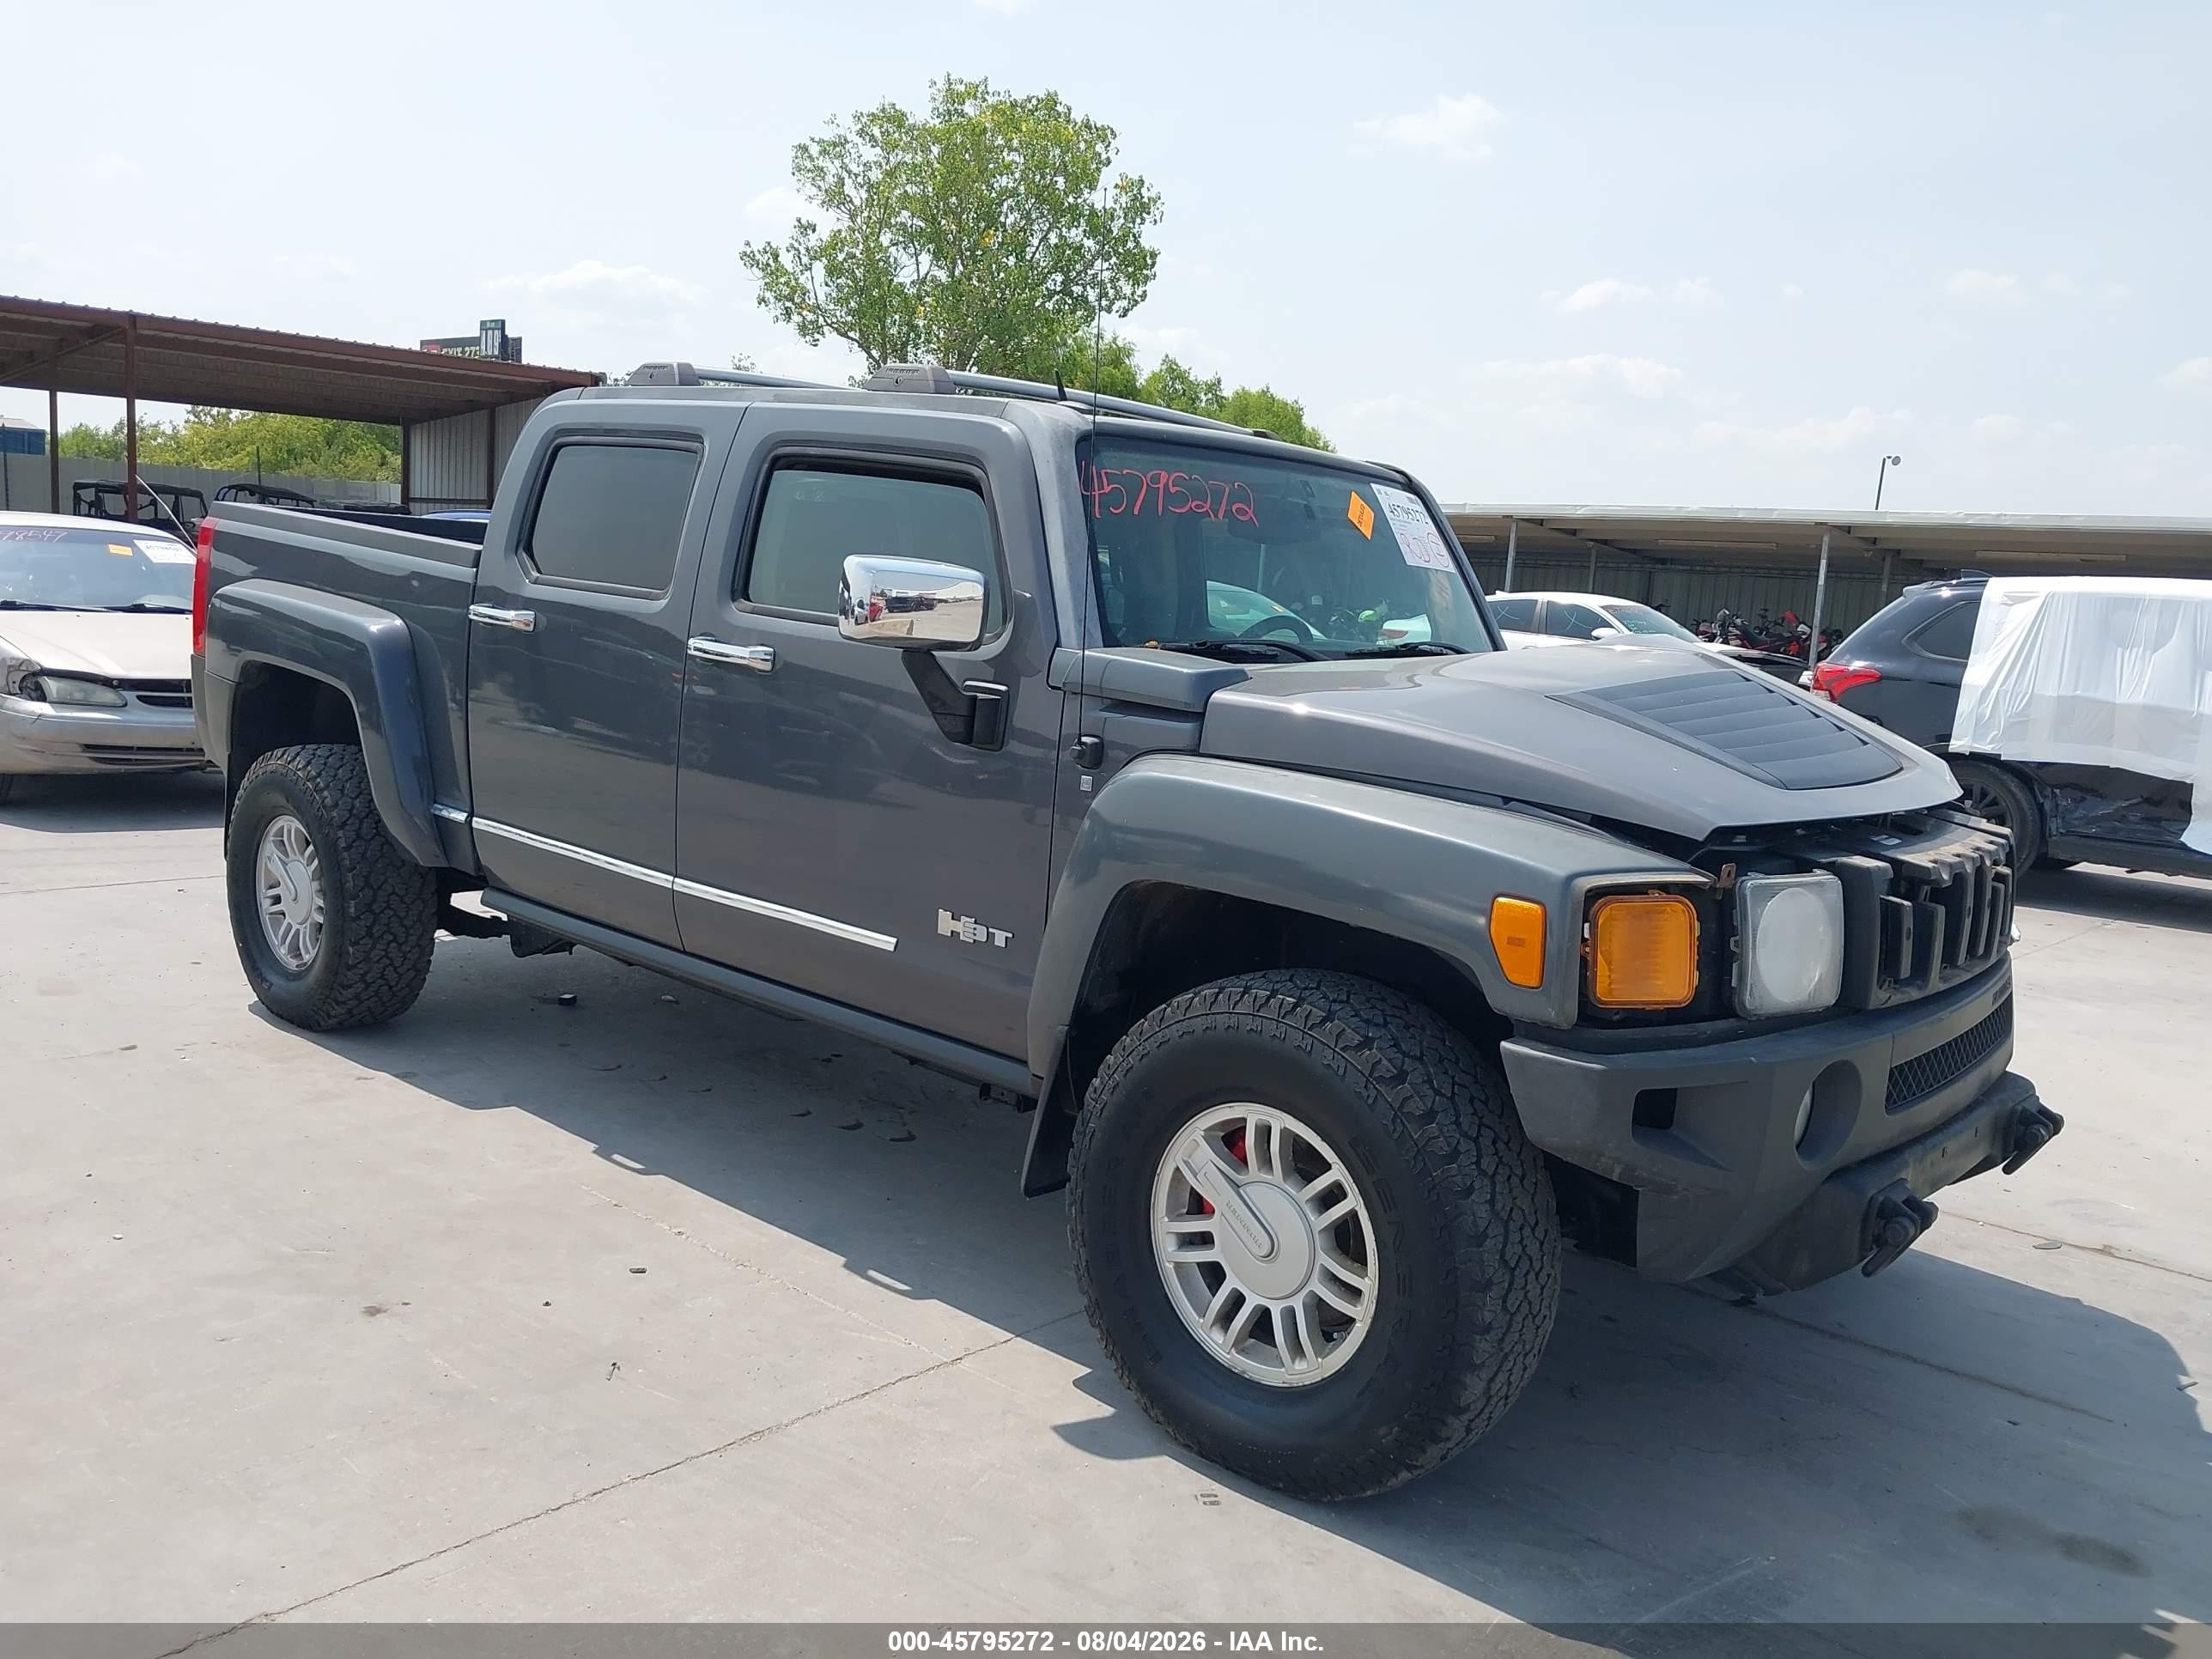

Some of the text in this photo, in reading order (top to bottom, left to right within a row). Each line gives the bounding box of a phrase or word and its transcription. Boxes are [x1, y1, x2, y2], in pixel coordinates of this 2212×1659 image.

[1080, 460, 1260, 528] 45795272
[1388, 503, 1430, 525] 45795272
[937, 908, 1014, 949] H3T
